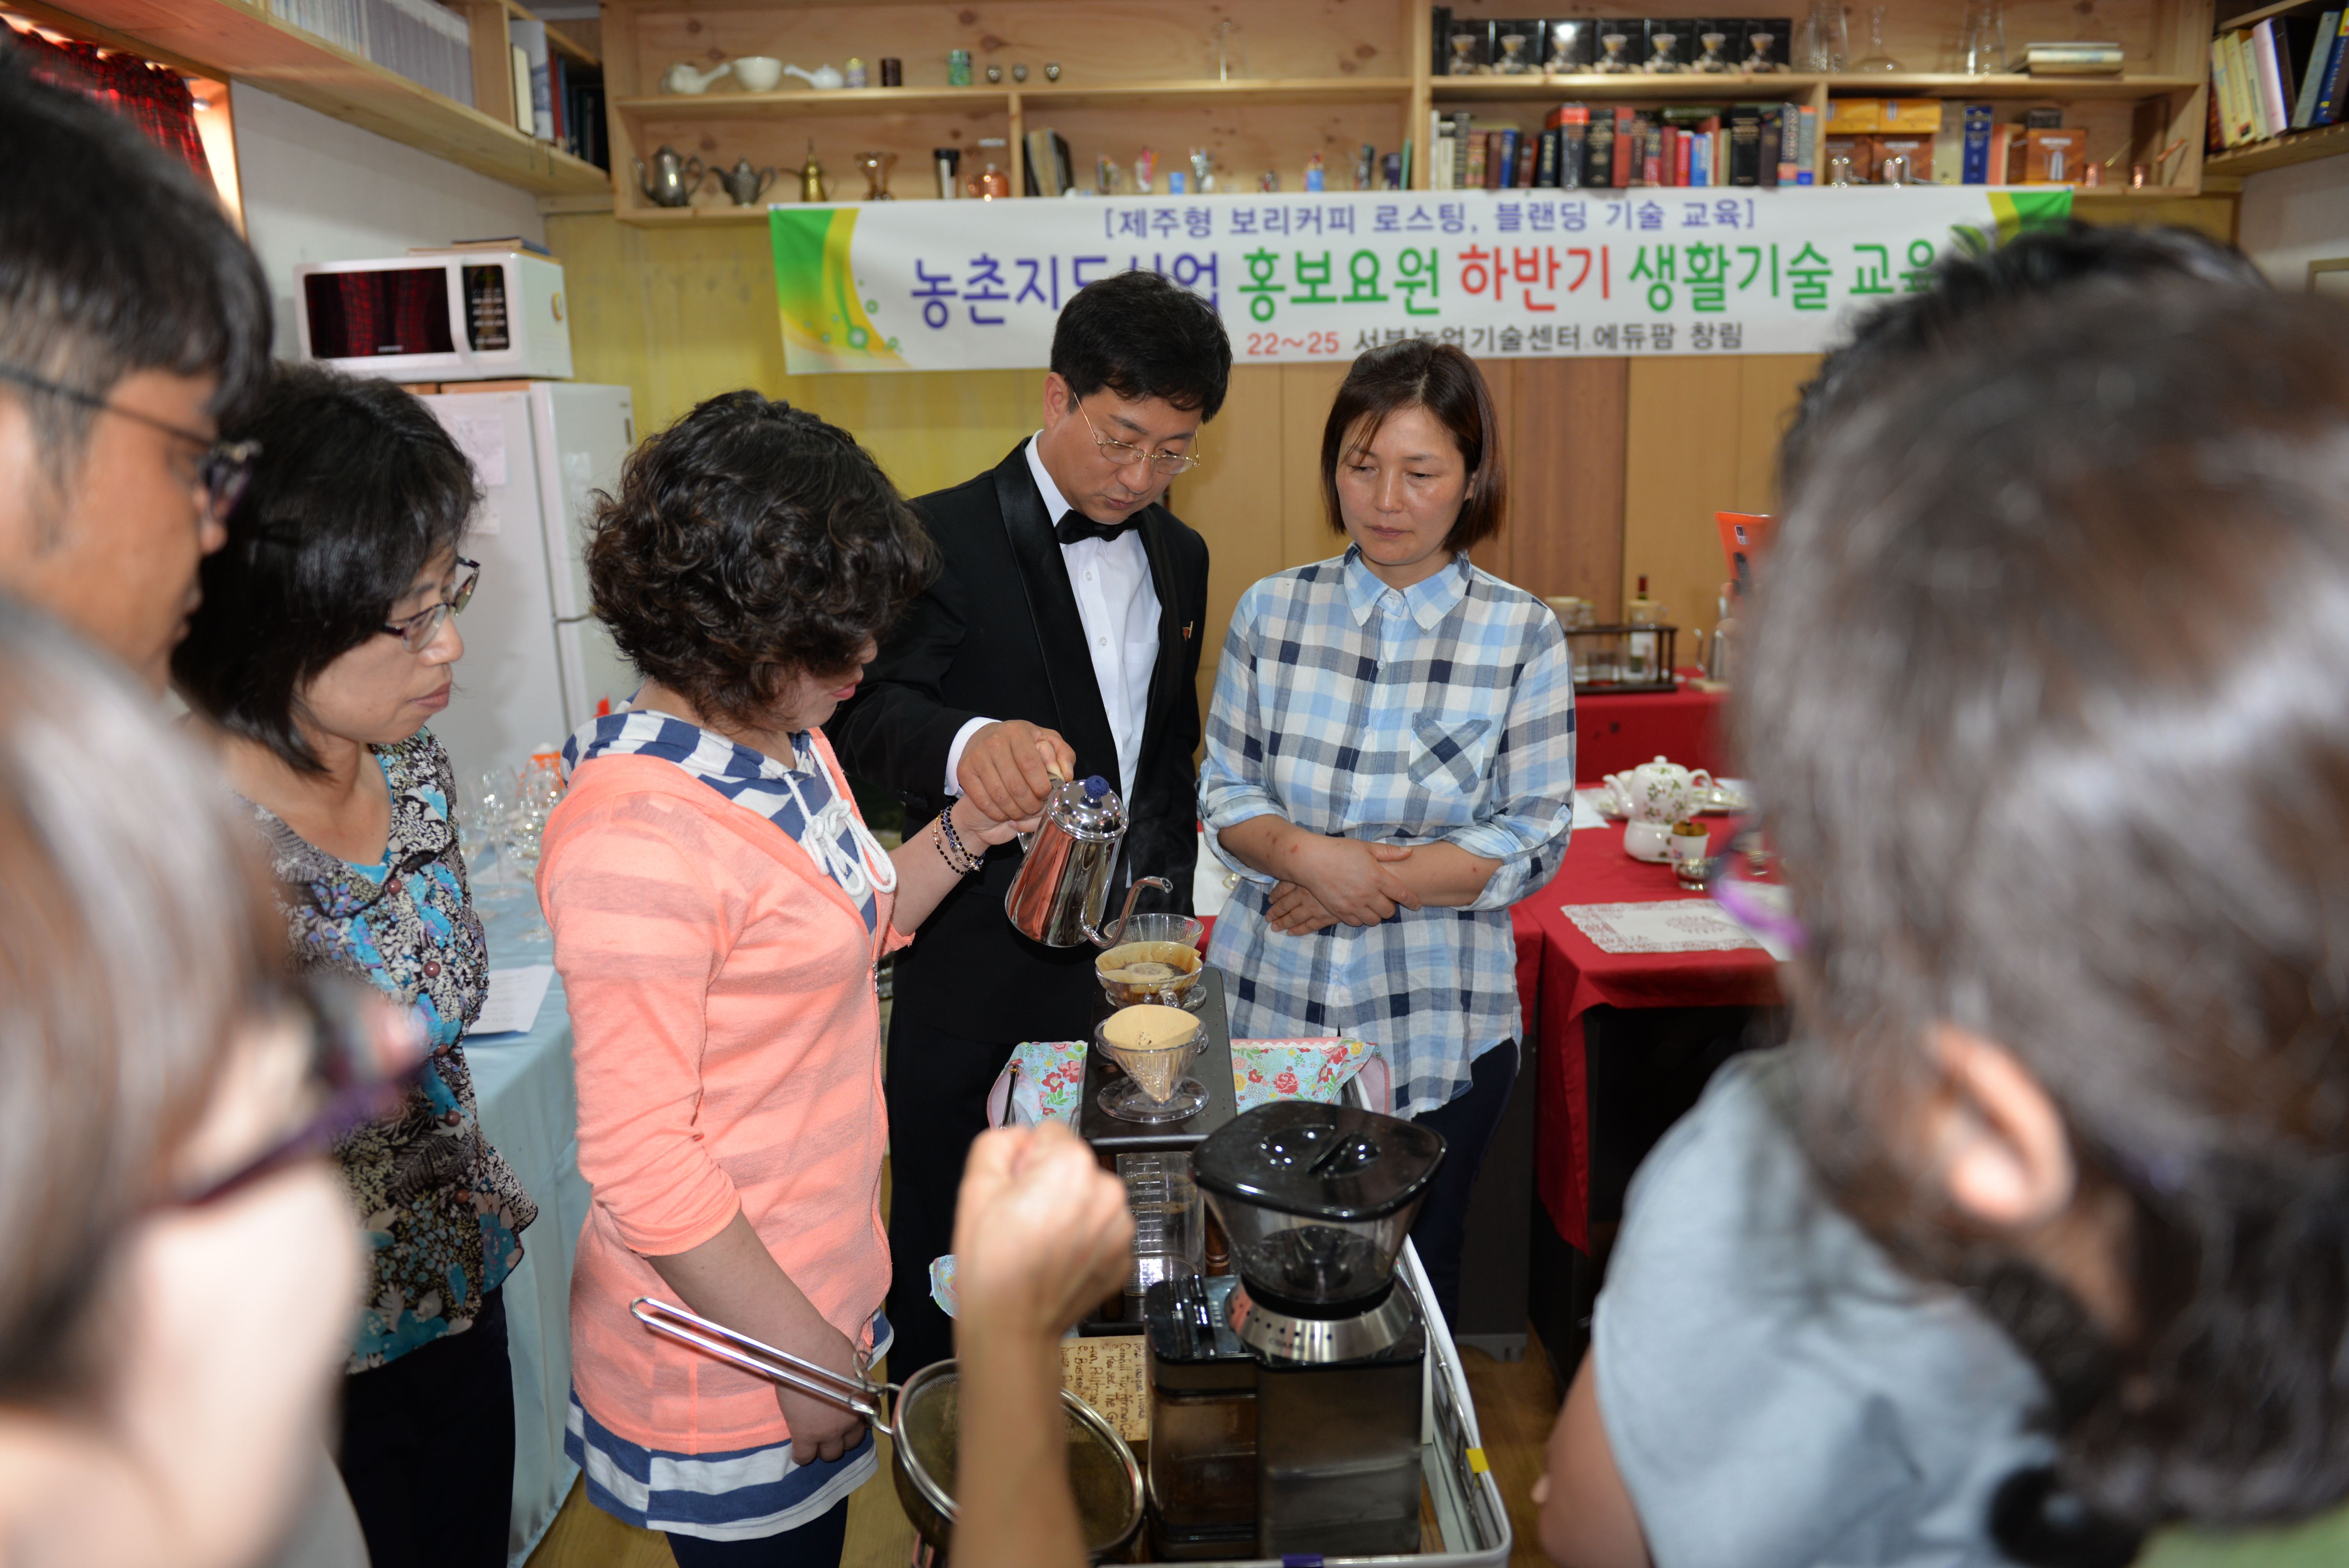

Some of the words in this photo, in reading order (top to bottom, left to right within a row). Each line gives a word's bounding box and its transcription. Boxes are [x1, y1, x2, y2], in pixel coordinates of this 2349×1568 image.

[1106, 207, 1211, 237] [제주형
[1230, 206, 1355, 235] 보리커피
[1373, 204, 1479, 237] 로스팅,
[1495, 202, 1587, 231] 블랜딩
[1609, 201, 1664, 230] 기술
[1682, 198, 1755, 228] 교육]
[1238, 246, 1442, 323] 홍보요원
[1458, 244, 1609, 312] 하반기
[1628, 241, 1833, 312] 생활기술
[1247, 332, 1340, 355] 22~25
[1691, 321, 1743, 350] 창림
